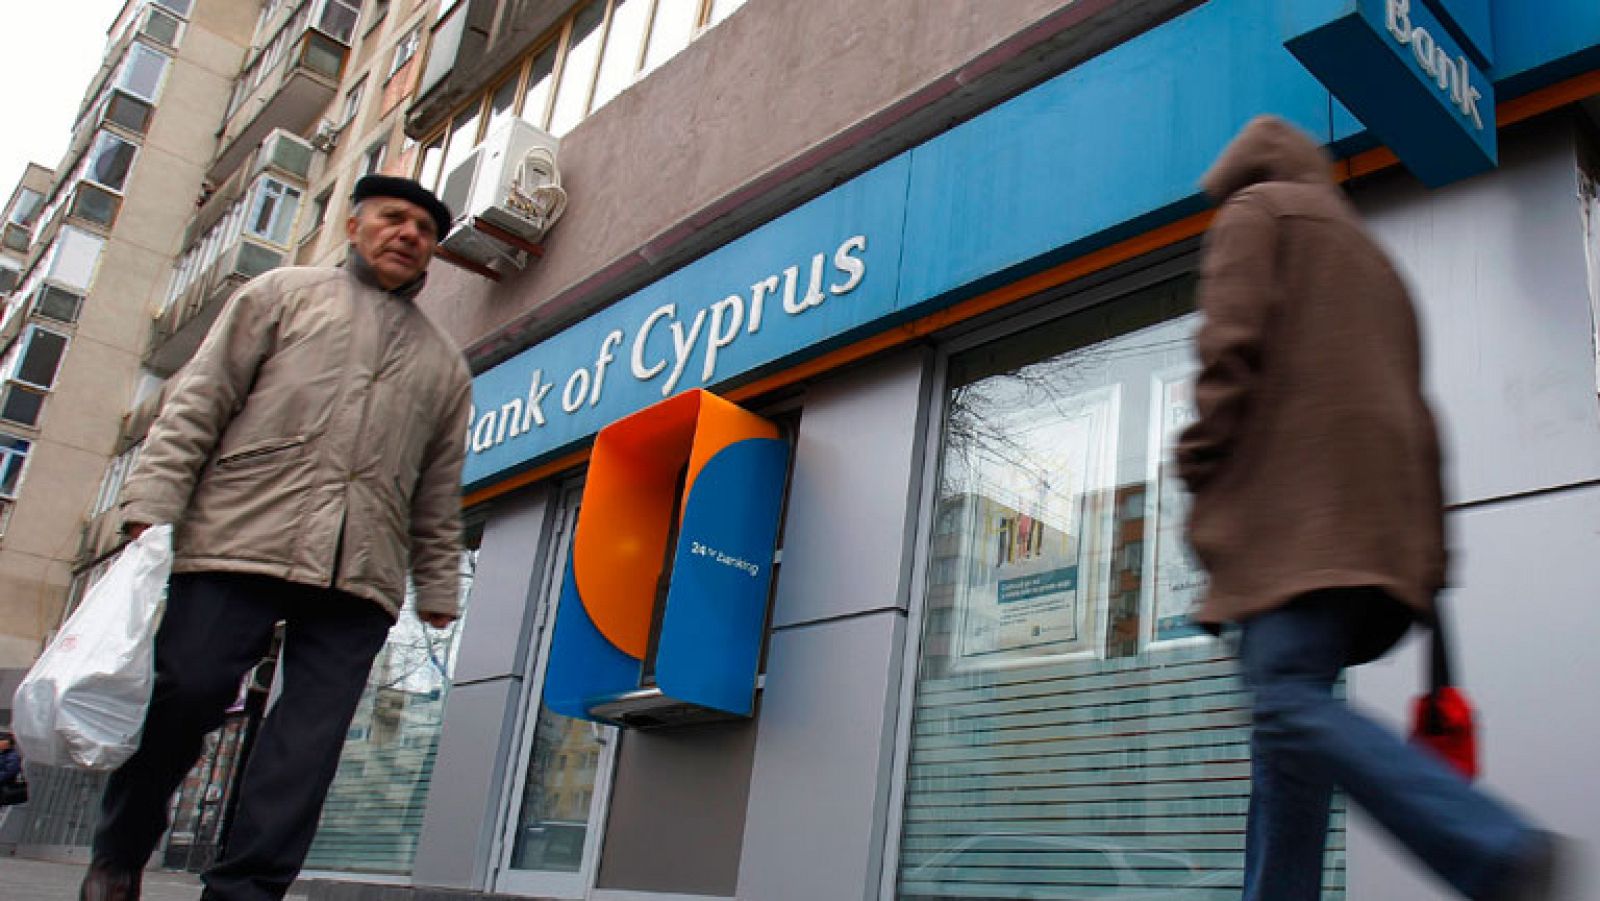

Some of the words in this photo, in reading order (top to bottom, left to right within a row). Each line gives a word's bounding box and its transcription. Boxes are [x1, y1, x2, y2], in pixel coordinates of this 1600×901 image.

[1386, 0, 1484, 130] Bank
[562, 329, 624, 413] of
[631, 235, 867, 396] Cyprus
[716, 551, 759, 576] banking
